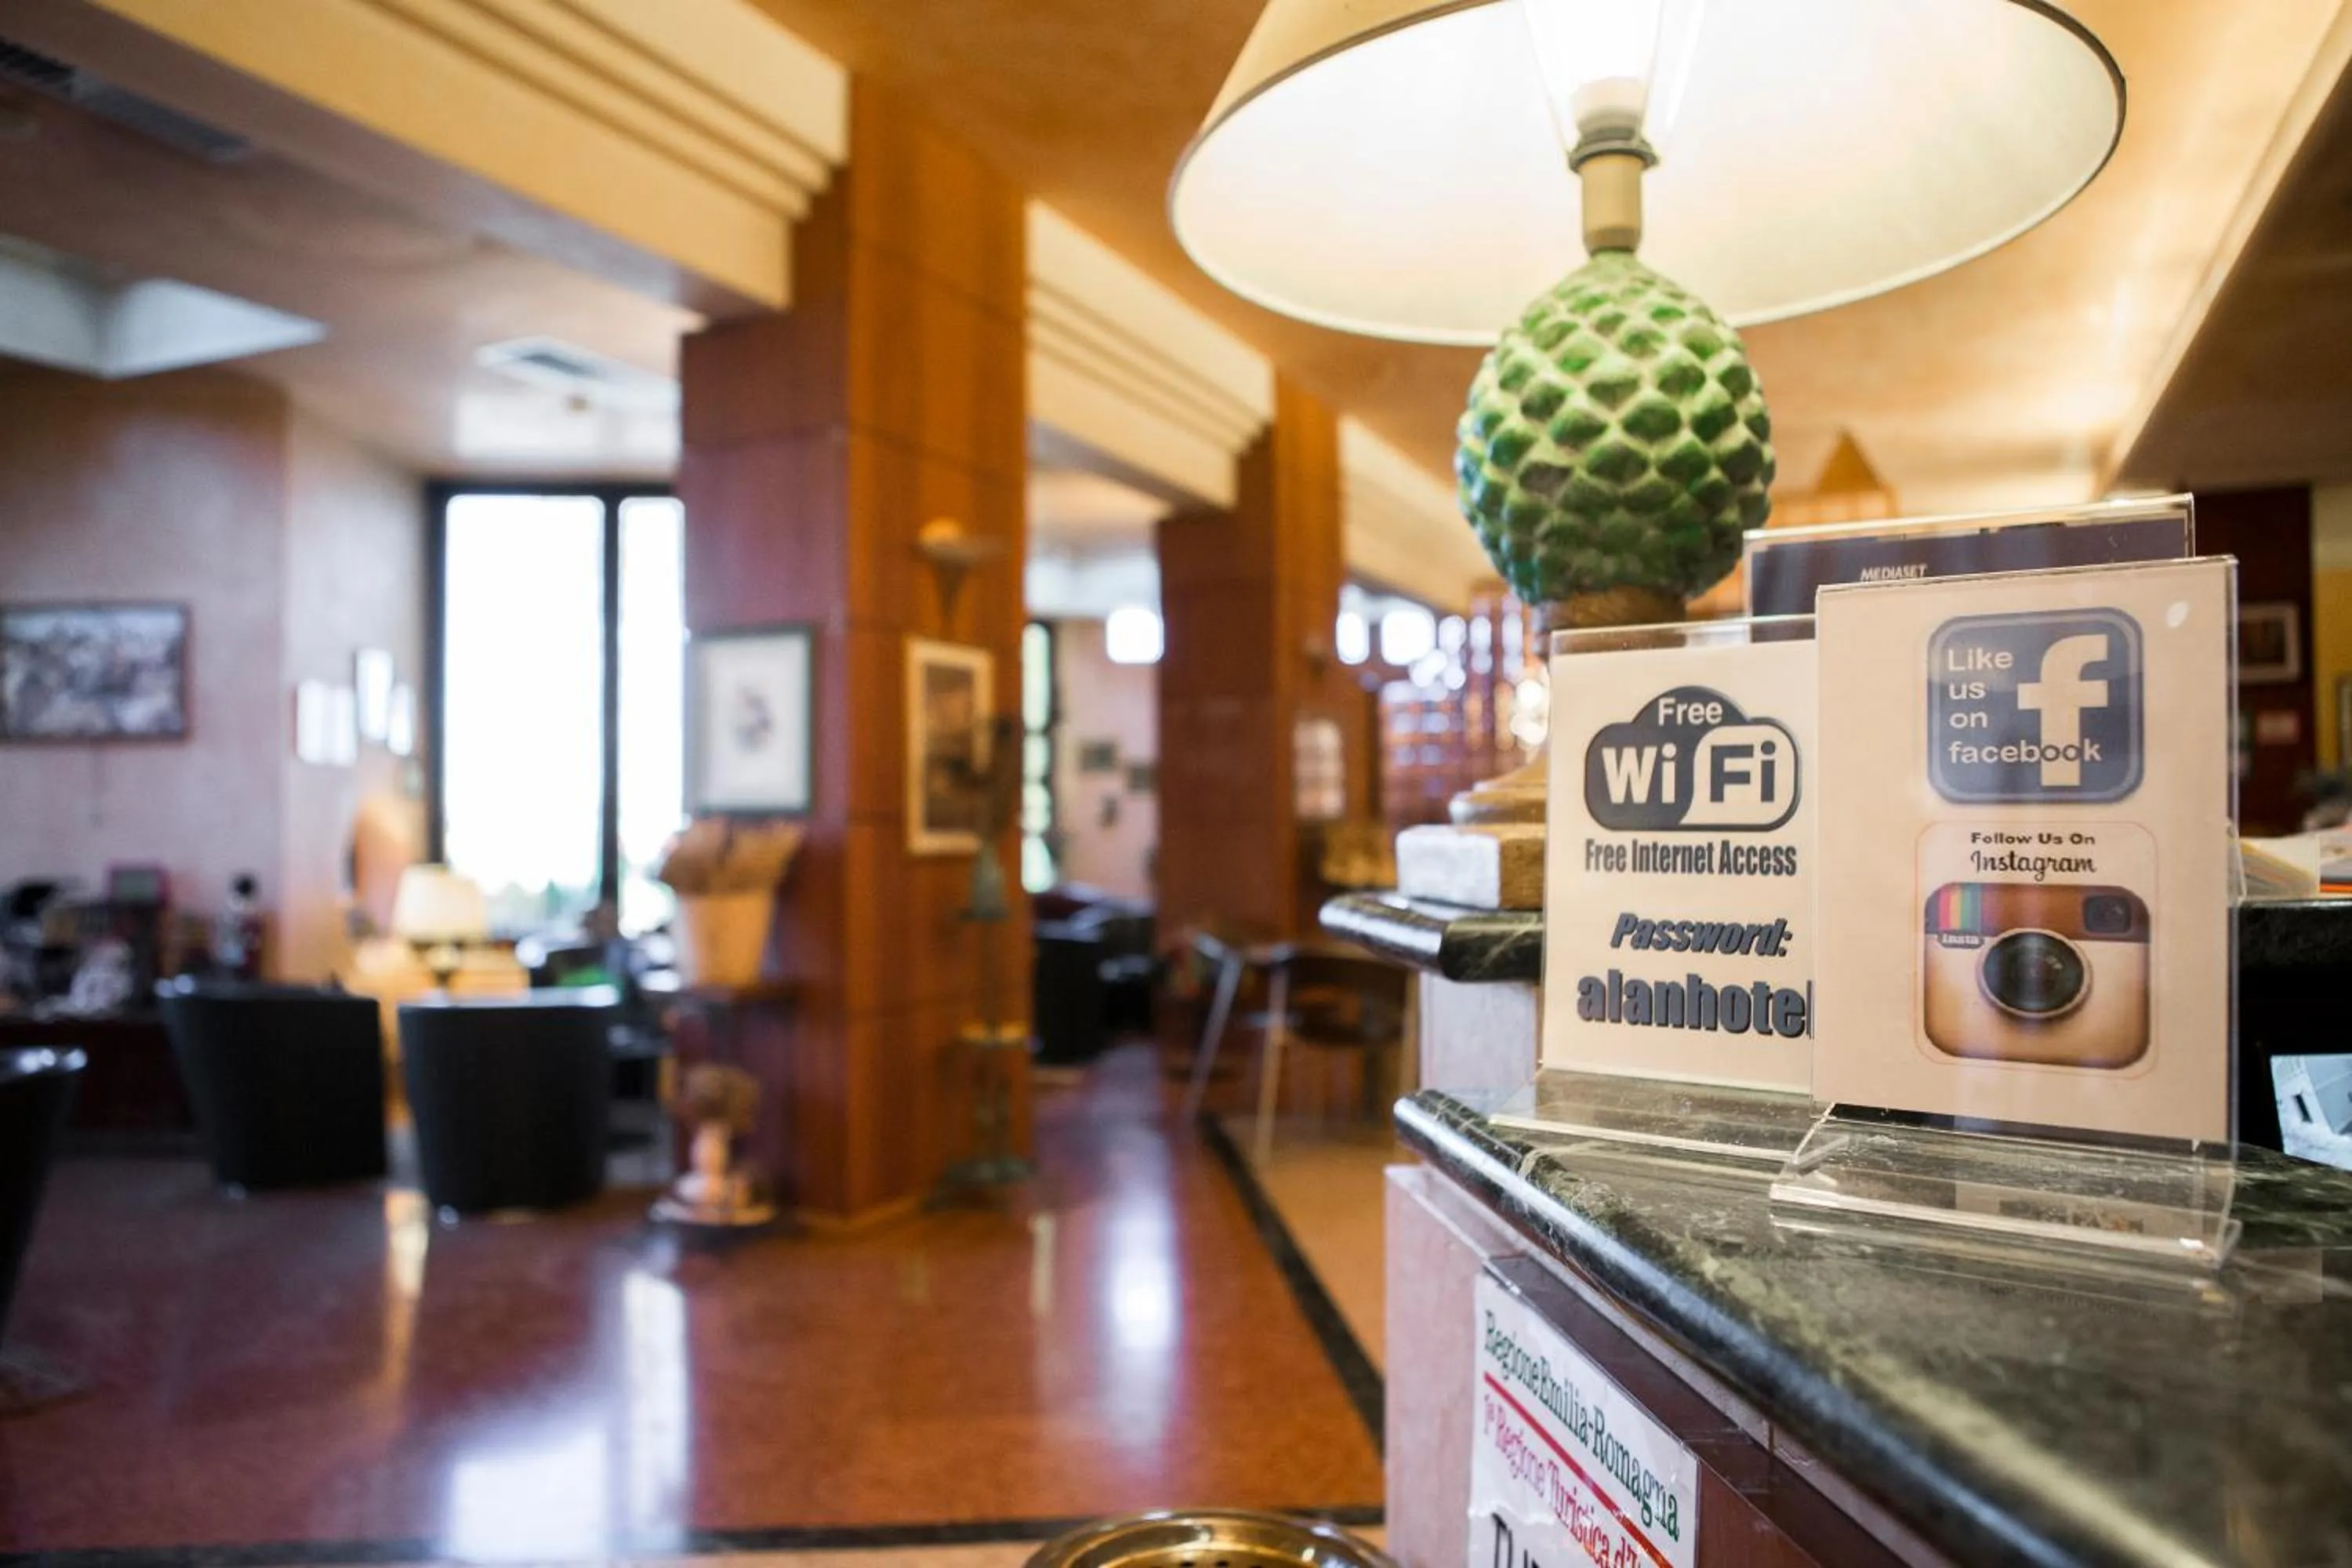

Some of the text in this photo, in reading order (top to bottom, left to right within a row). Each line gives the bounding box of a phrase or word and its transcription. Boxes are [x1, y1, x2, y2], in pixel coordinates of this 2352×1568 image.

[1860, 563, 1928, 583] MEDIASET
[1947, 648, 2013, 672] Like
[1949, 681, 1986, 701] us
[1657, 697, 1722, 727] Free
[1949, 710, 1988, 730] on
[1948, 739, 2102, 766] facebook
[1971, 832, 2096, 845] Follow Us On
[1585, 838, 1797, 877] Free Internet Access
[1970, 850, 2097, 882] Instagram
[1610, 912, 1793, 957] Password:
[1495, 1404, 1544, 1498] Regione
